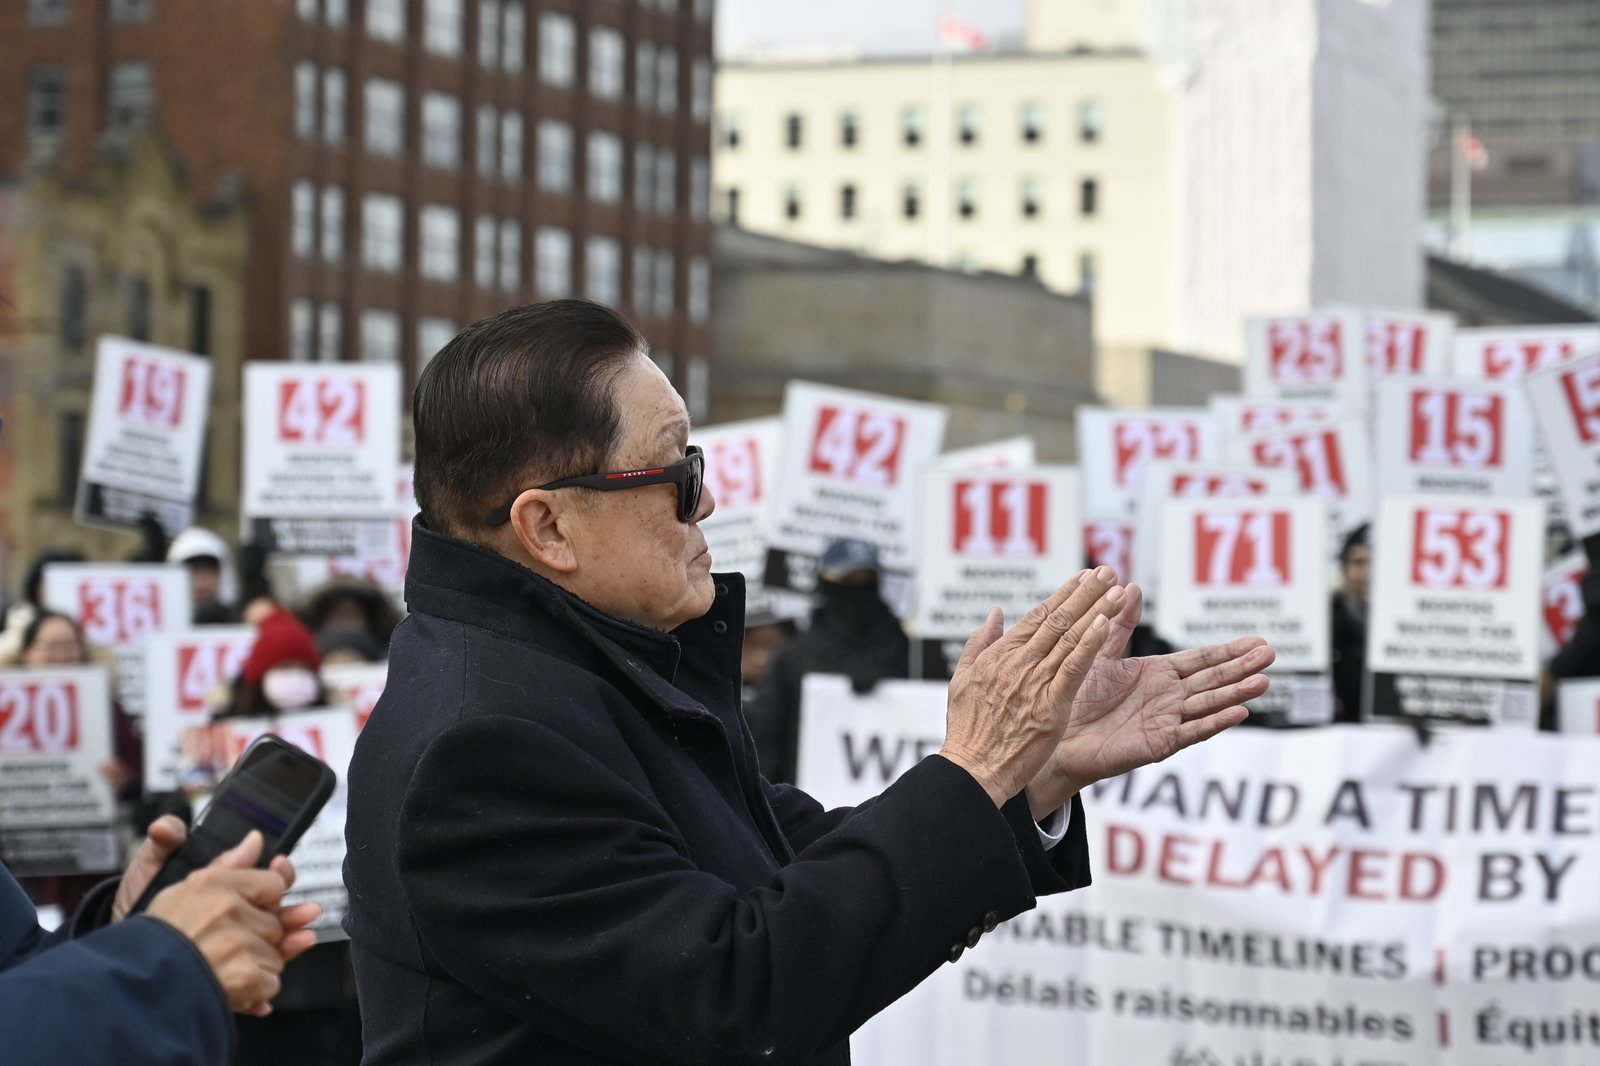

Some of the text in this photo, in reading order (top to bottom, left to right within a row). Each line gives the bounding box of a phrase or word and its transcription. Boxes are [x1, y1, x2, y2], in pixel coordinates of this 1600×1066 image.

[281, 379, 363, 442] 42
[814, 406, 904, 486] 42
[1417, 388, 1497, 467] 15
[957, 480, 1042, 556] 11
[1199, 512, 1286, 585] 71
[1415, 510, 1506, 591] 53
[81, 579, 160, 646] 36
[0, 682, 76, 750] 20
[1323, 779, 1372, 831] A
[1400, 783, 1595, 834] TIME
[1107, 825, 1577, 905] DELAYED BY
[1157, 918, 1408, 980] TIMELINES
[964, 968, 1099, 1011] Délais
[1113, 982, 1415, 1040] raisonnables
